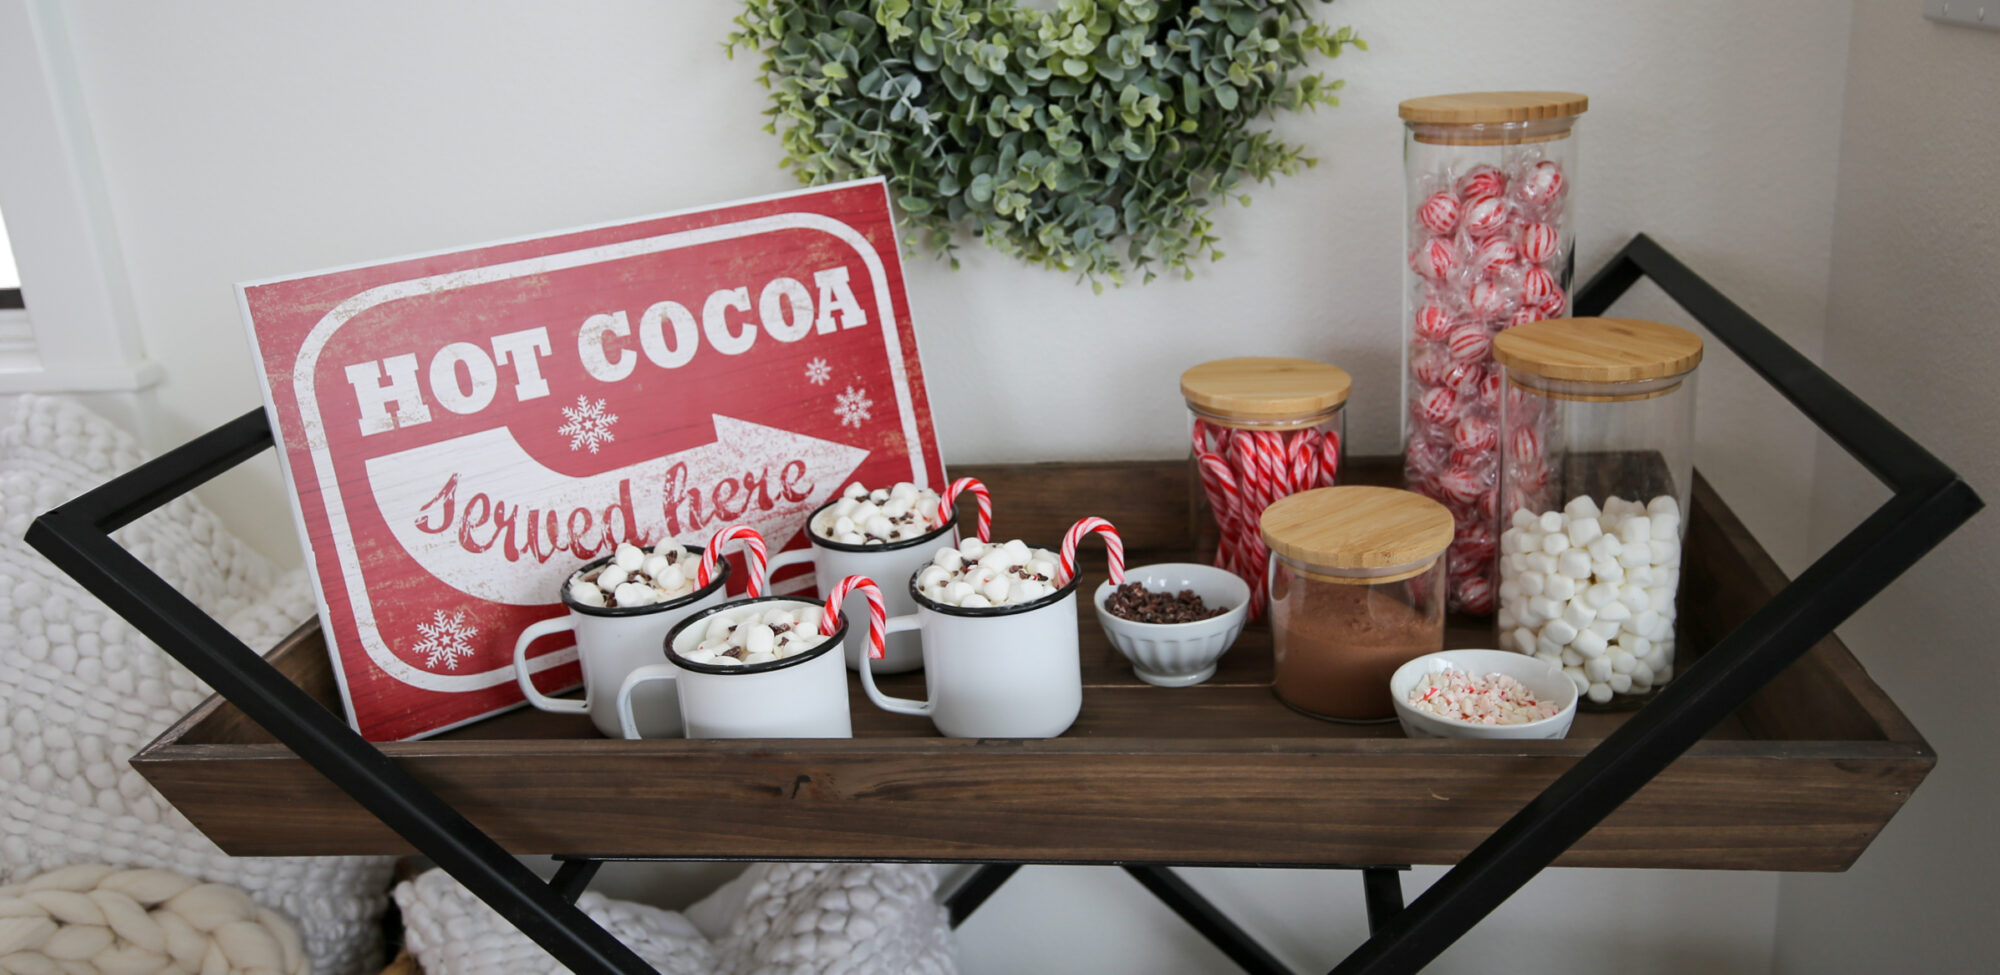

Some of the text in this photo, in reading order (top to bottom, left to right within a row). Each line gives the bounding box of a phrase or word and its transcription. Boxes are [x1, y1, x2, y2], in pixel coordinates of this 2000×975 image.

[344, 266, 868, 437] HOT COCOA
[663, 460, 816, 537] here
